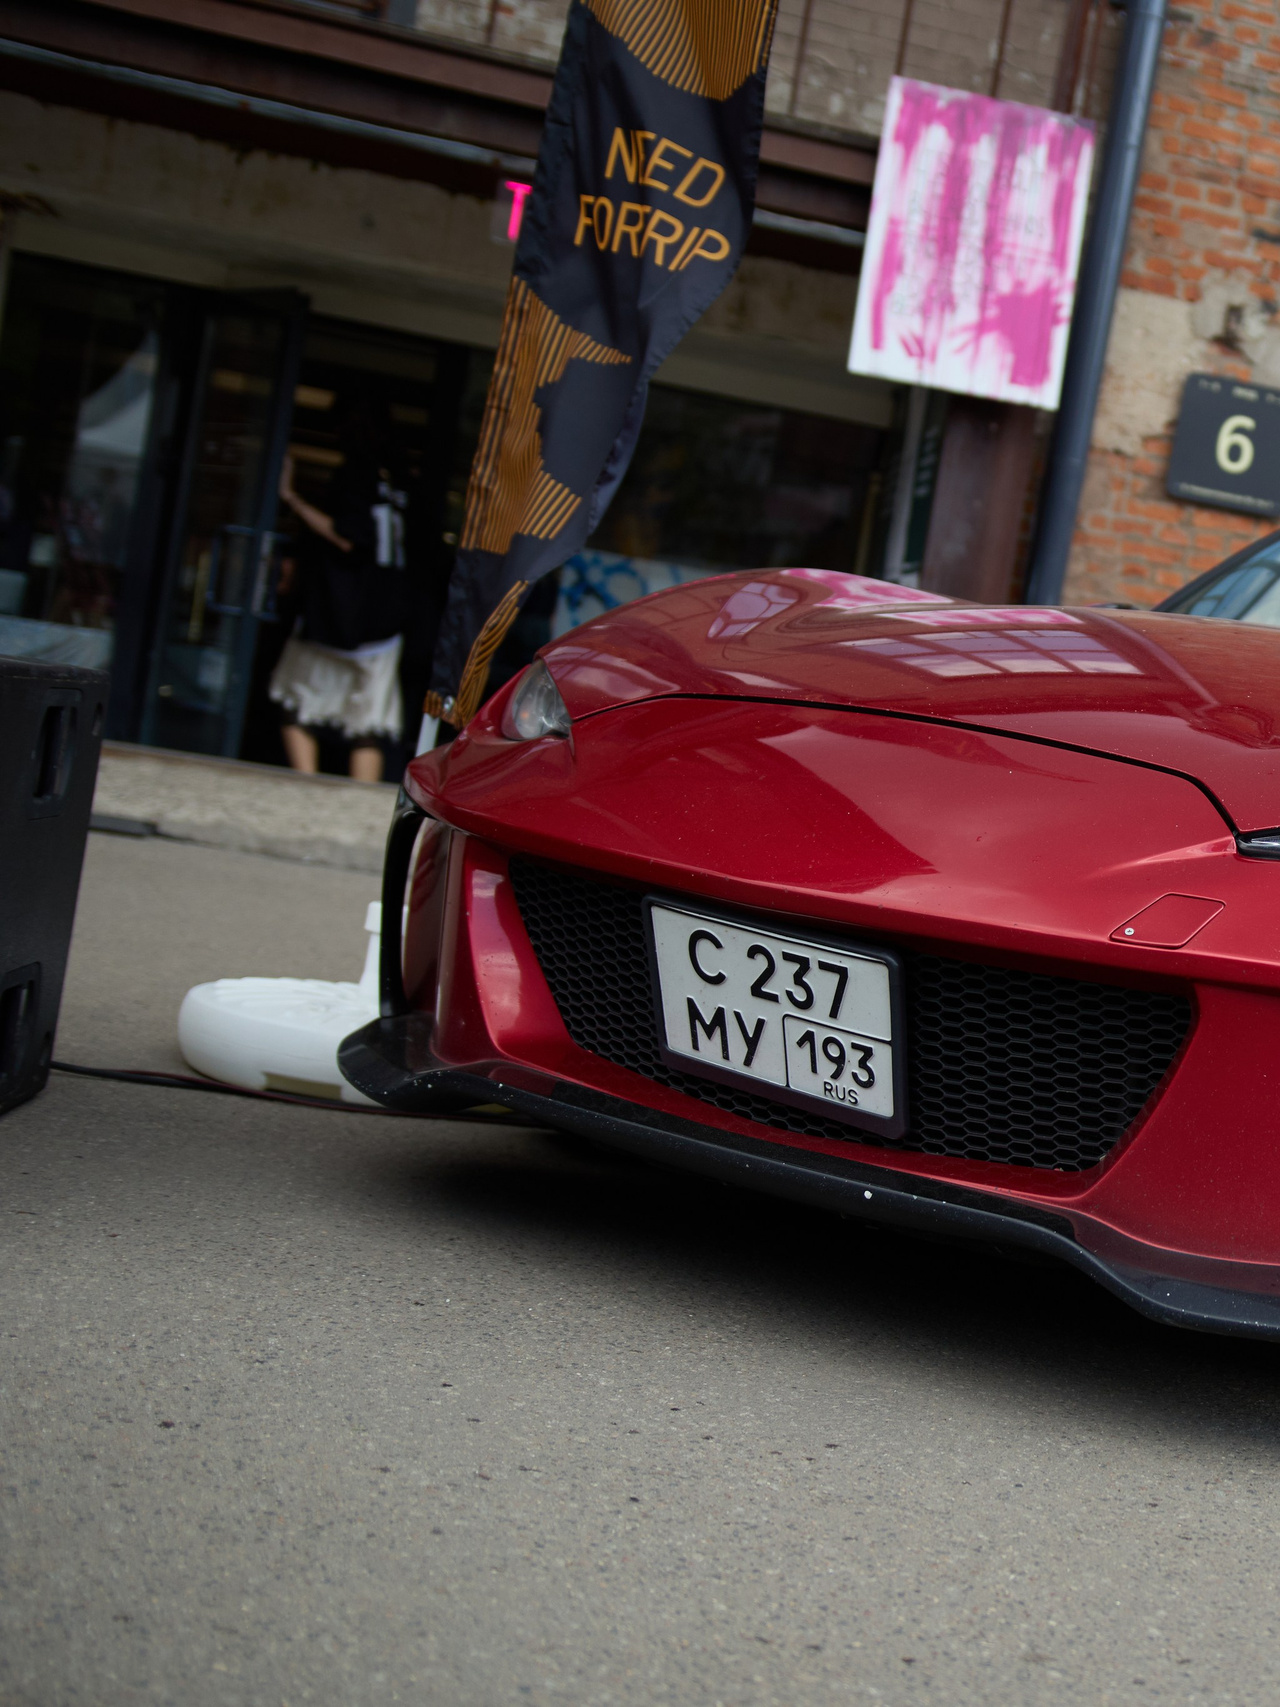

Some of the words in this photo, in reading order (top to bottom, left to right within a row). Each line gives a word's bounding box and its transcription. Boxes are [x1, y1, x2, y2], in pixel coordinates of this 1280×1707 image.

[605, 127, 725, 207] NEED
[1216, 414, 1257, 474] 6
[747, 944, 849, 1019] 237
[796, 1029, 876, 1089] 193
[823, 1080, 859, 1104] RUS
